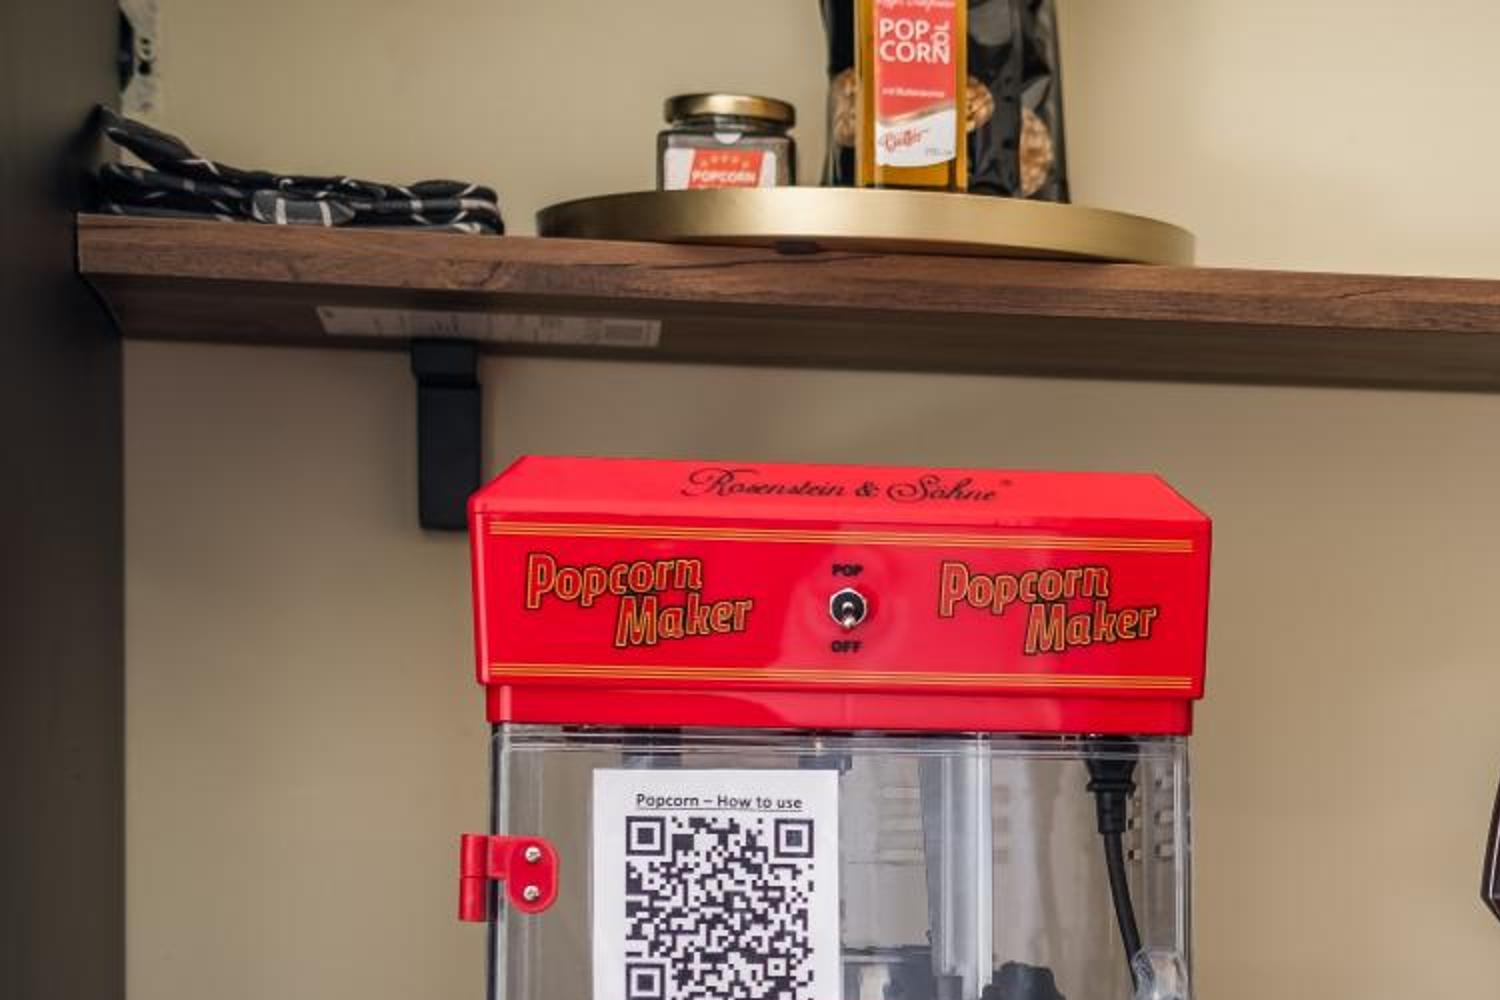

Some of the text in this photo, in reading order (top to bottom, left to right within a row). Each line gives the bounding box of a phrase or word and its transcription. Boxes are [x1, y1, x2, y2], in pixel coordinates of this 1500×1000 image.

[879, 18, 930, 40] POP
[879, 39, 950, 64] CORN
[692, 170, 757, 183] POPCORN
[680, 467, 844, 497] Rosenstein
[855, 480, 878, 497] &
[525, 551, 704, 612] Popcorn
[831, 563, 864, 577] POP
[938, 560, 1109, 619] Popcorn
[612, 591, 755, 650] Maker
[1022, 598, 1160, 657] Maker
[831, 640, 862, 653] OFF
[636, 793, 699, 808] Popcorn
[717, 794, 750, 807] How
[757, 796, 772, 808] to
[777, 799, 803, 809] use
